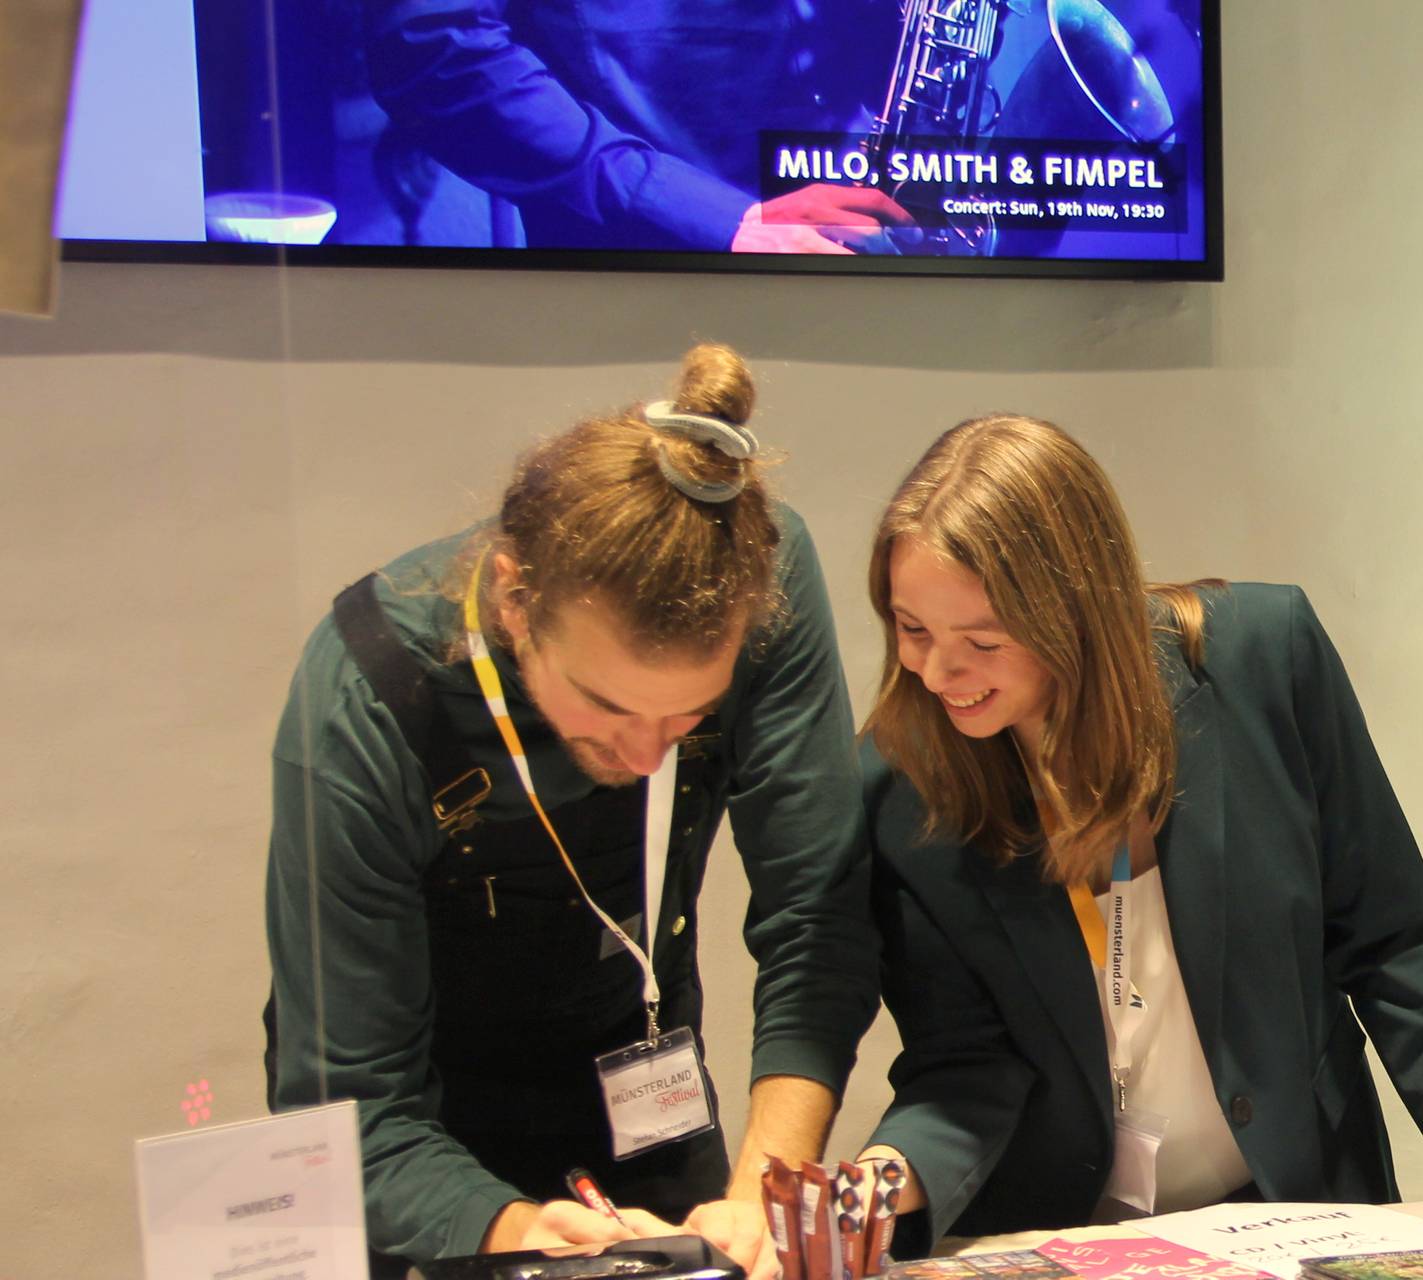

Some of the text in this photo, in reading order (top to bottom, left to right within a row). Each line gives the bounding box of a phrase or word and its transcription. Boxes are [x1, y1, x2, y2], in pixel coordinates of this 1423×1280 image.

[778, 149, 1164, 188] MILO, SMITH & FIMPEL
[943, 198, 1165, 220] Concert: Sun, 19th Nov, 19:30
[1113, 895, 1123, 1006] muensterland.com
[1212, 1211, 1352, 1234] Verkauf
